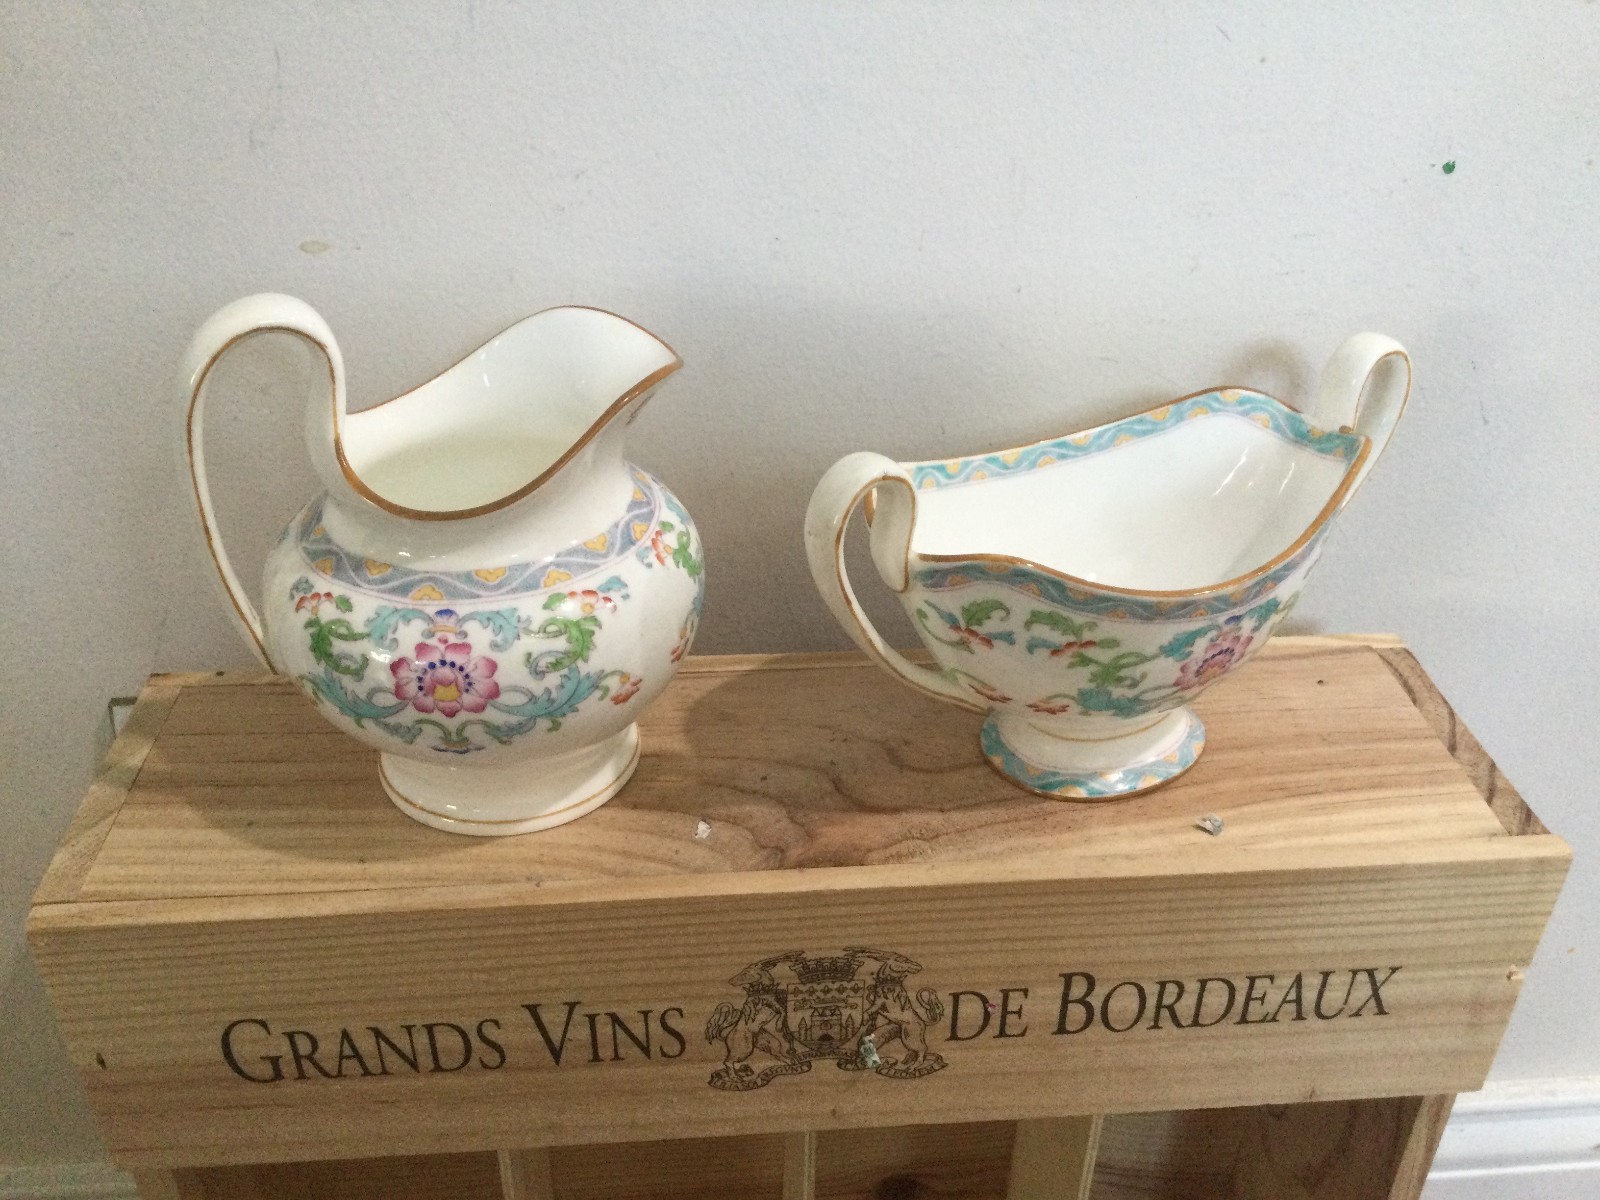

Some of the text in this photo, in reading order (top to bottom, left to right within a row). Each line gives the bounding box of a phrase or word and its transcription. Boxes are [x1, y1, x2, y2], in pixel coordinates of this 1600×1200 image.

[221, 965, 1403, 1083] GRANDS VINS DE BORDEAUX
